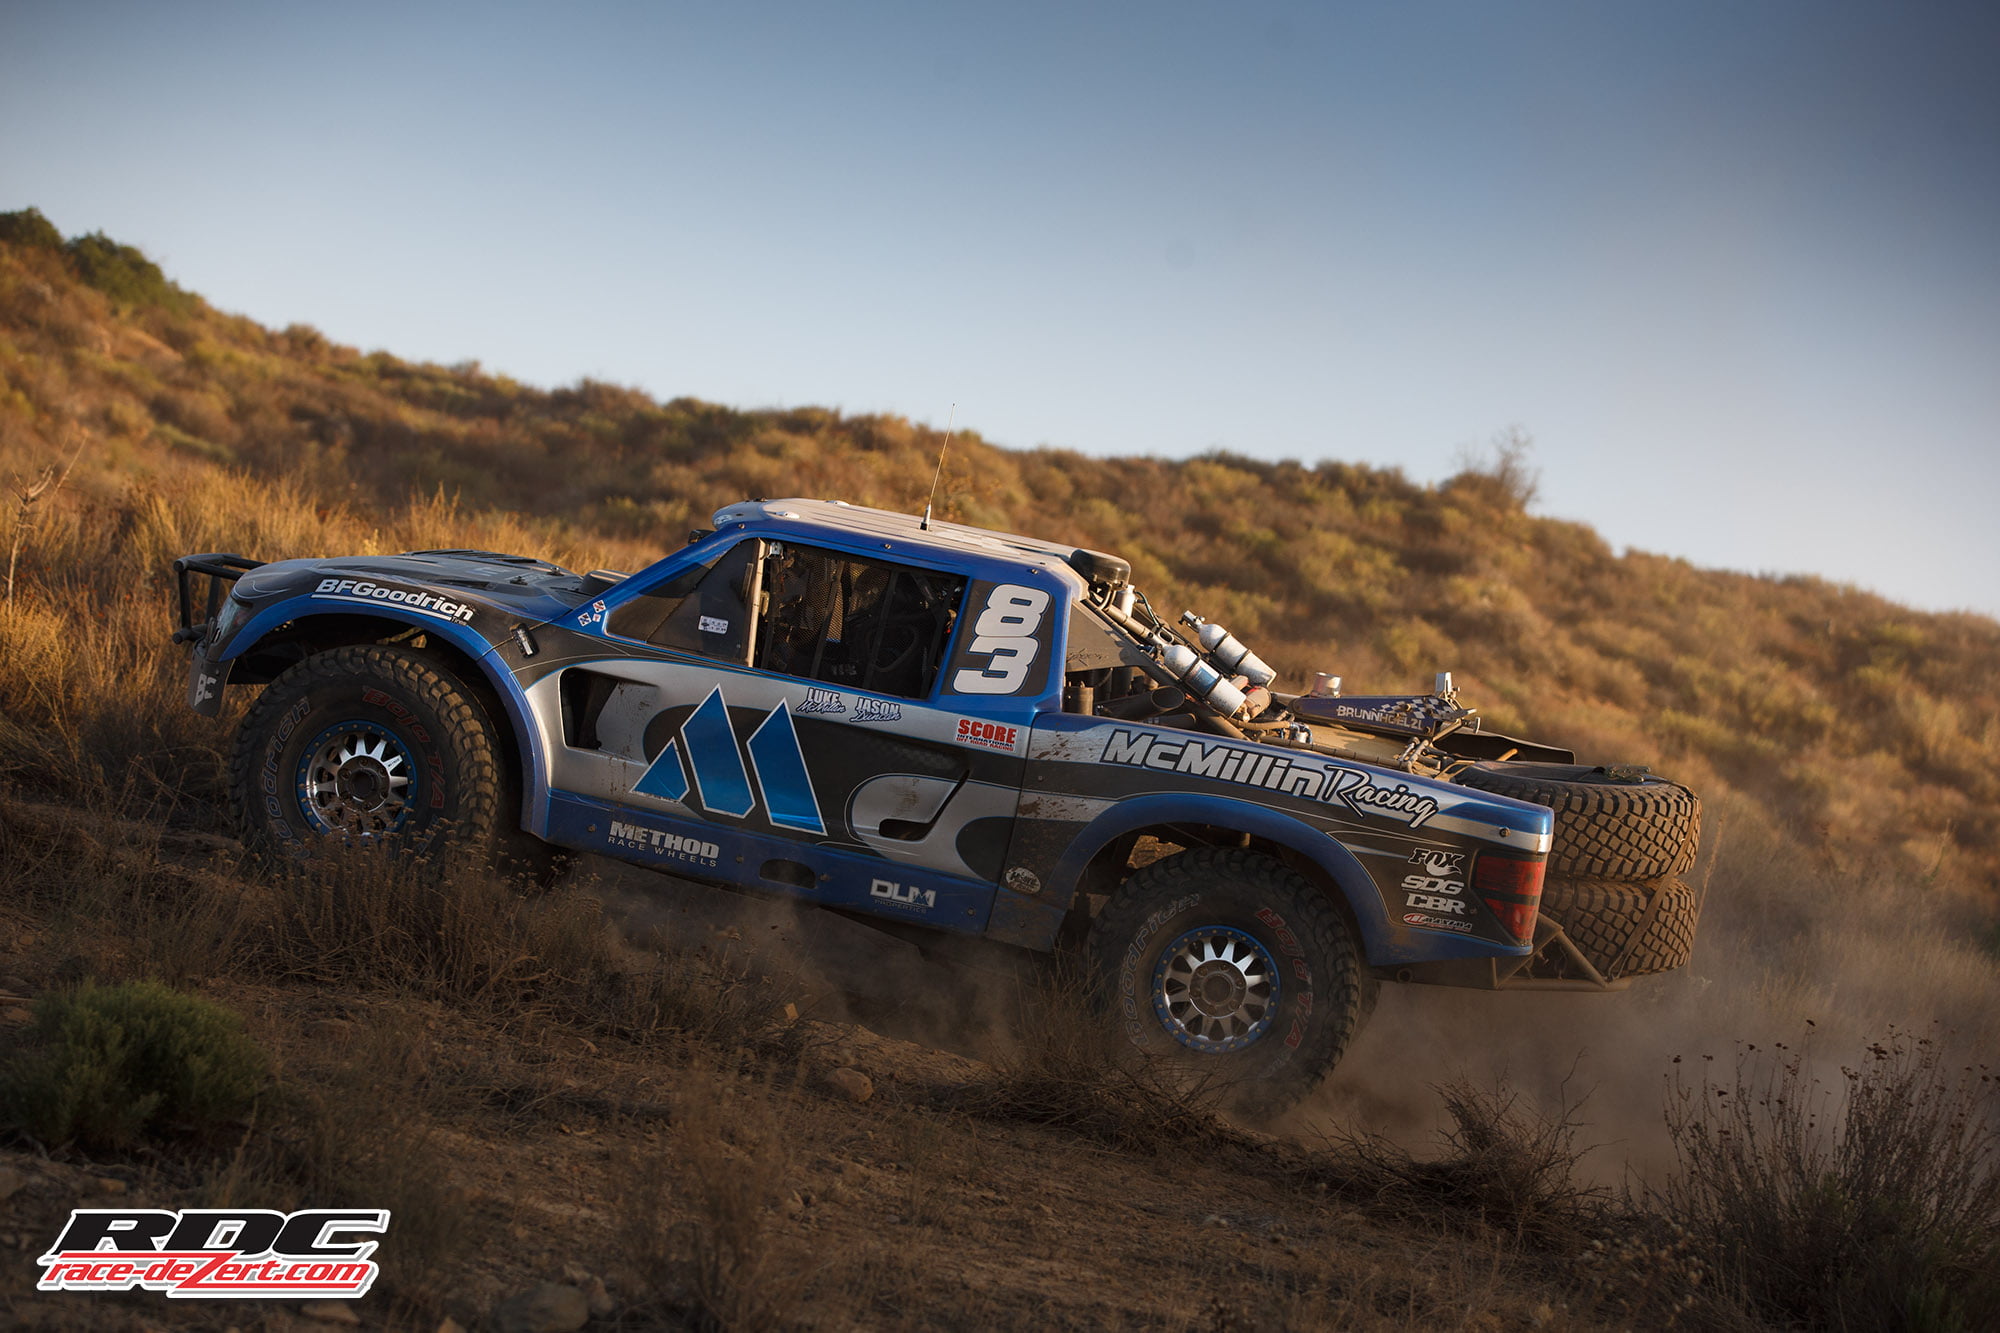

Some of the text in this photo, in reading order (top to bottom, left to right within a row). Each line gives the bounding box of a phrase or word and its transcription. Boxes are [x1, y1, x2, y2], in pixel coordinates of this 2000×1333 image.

[314, 578, 475, 621] BFGoodrich
[952, 583, 1050, 695] 83
[806, 687, 840, 704] LUKE
[855, 697, 900, 714] JASON
[362, 685, 432, 743] Baja
[849, 711, 902, 722] Duncan
[957, 719, 1017, 744] SCORE
[957, 734, 1014, 747] INTERNATIONAL
[426, 751, 446, 809] T/A
[1101, 729, 1440, 830] McMillin Racing
[608, 836, 717, 868] RACE WHEELS
[609, 820, 720, 860] METHOD
[1407, 847, 1466, 873] FOX
[870, 878, 937, 908] DLM
[1400, 874, 1465, 896] SDG
[1405, 892, 1466, 915] CBR
